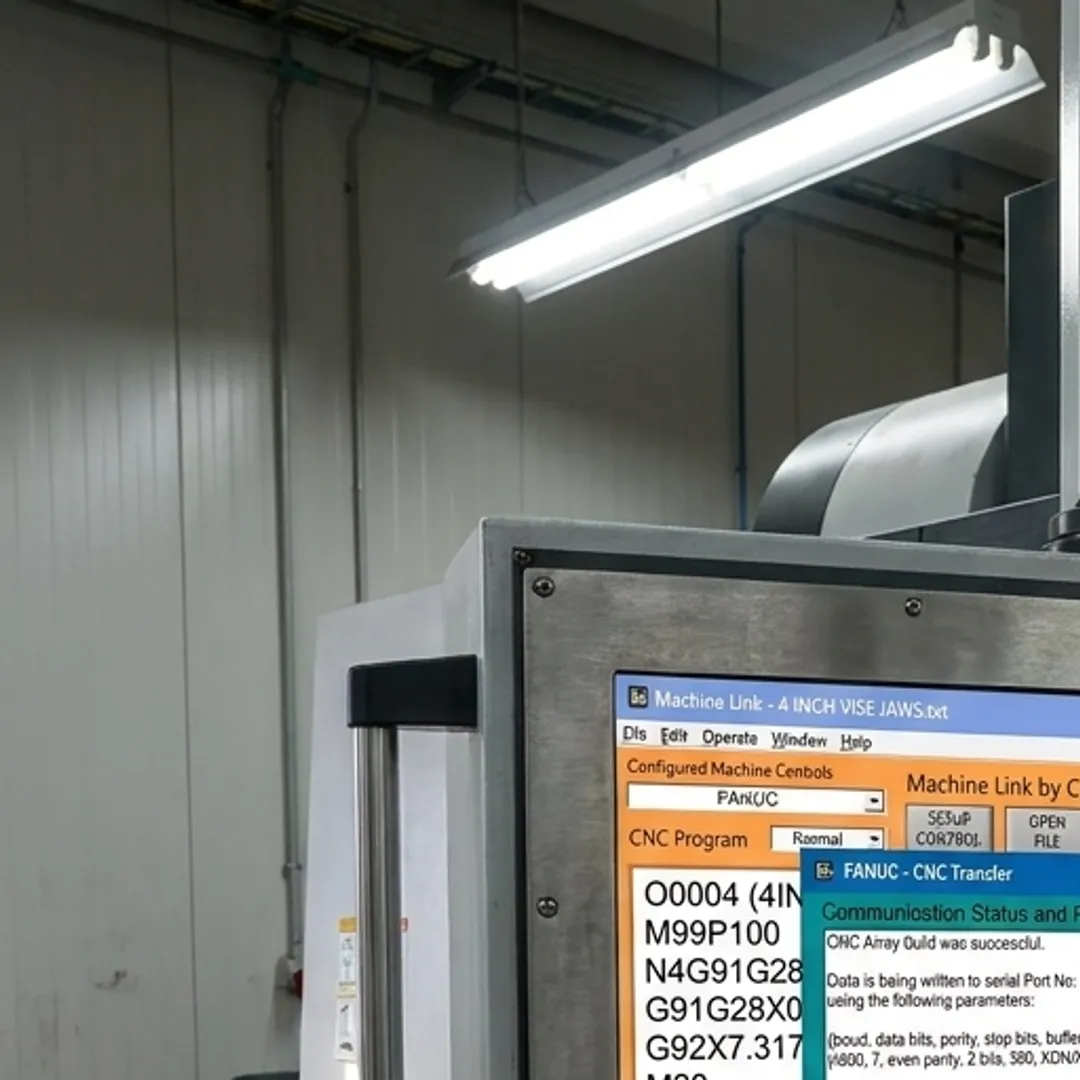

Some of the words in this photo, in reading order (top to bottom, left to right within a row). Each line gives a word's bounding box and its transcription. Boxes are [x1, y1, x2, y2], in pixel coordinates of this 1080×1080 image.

[777, 697, 789, 711] 4
[793, 698, 835, 715] INCH
[840, 700, 875, 717] VISE
[878, 701, 949, 720] JAWS.txt
[626, 758, 707, 779] Configured
[711, 761, 771, 778] Machine
[907, 774, 988, 795] Machine
[995, 776, 1033, 796] Link
[1038, 777, 1062, 802] by
[628, 829, 669, 847] CNC
[674, 829, 748, 852] Program
[844, 862, 899, 880] FANUC
[913, 863, 947, 881] CNC
[972, 903, 1028, 923] Status
[1033, 905, 1067, 924] and
[645, 919, 780, 946] M99P100
[645, 958, 803, 984] N4G91G28
[863, 973, 875, 988] is
[964, 974, 981, 988] to
[984, 973, 1020, 988] serial
[1023, 973, 1051, 988] Port
[645, 996, 803, 1022] G91G28X0
[868, 993, 889, 1008] the
[956, 994, 1035, 1011] parameters:
[645, 1034, 803, 1061] G92X7.317
[875, 1032, 905, 1047] data
[888, 1053, 921, 1067] even
[968, 1051, 976, 1067] 2
